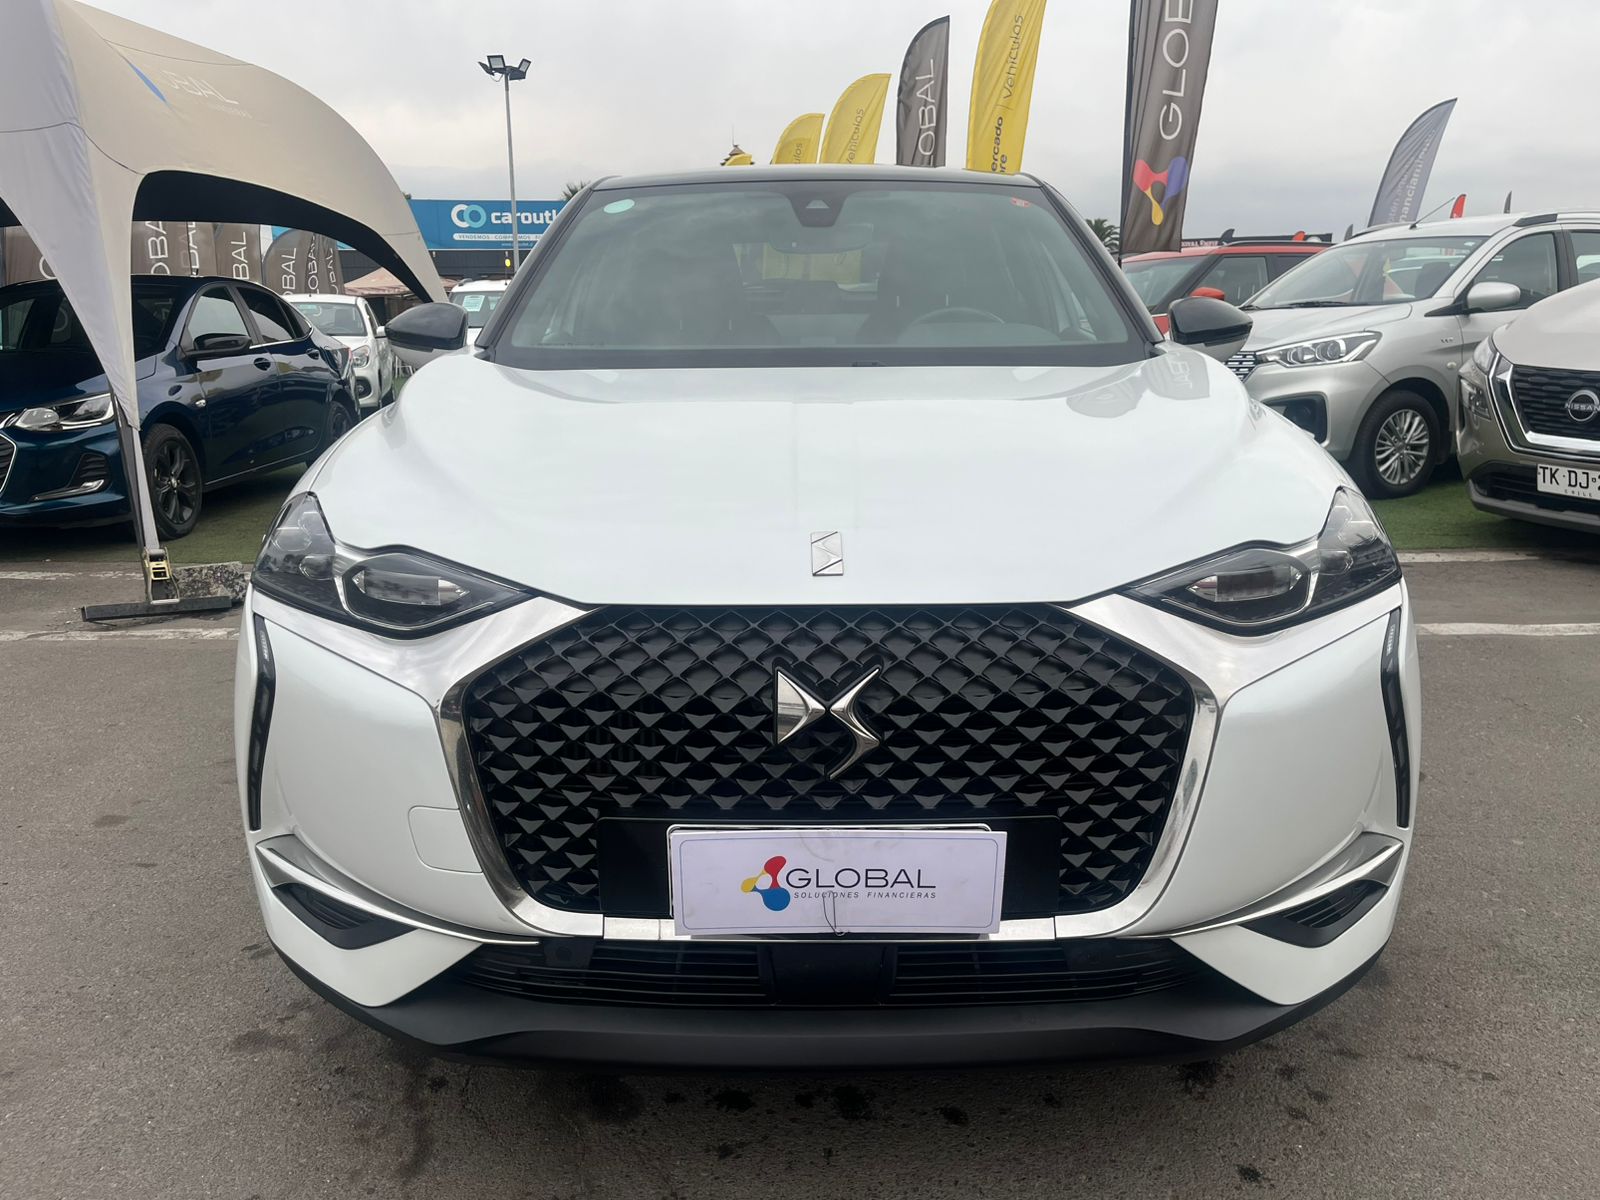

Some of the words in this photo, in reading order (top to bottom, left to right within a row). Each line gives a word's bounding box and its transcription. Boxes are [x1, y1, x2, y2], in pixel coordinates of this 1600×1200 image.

[785, 868, 937, 889] GLOBAL
[794, 891, 860, 899] SOLUCIONES
[867, 891, 937, 899] FINANCIERAS
